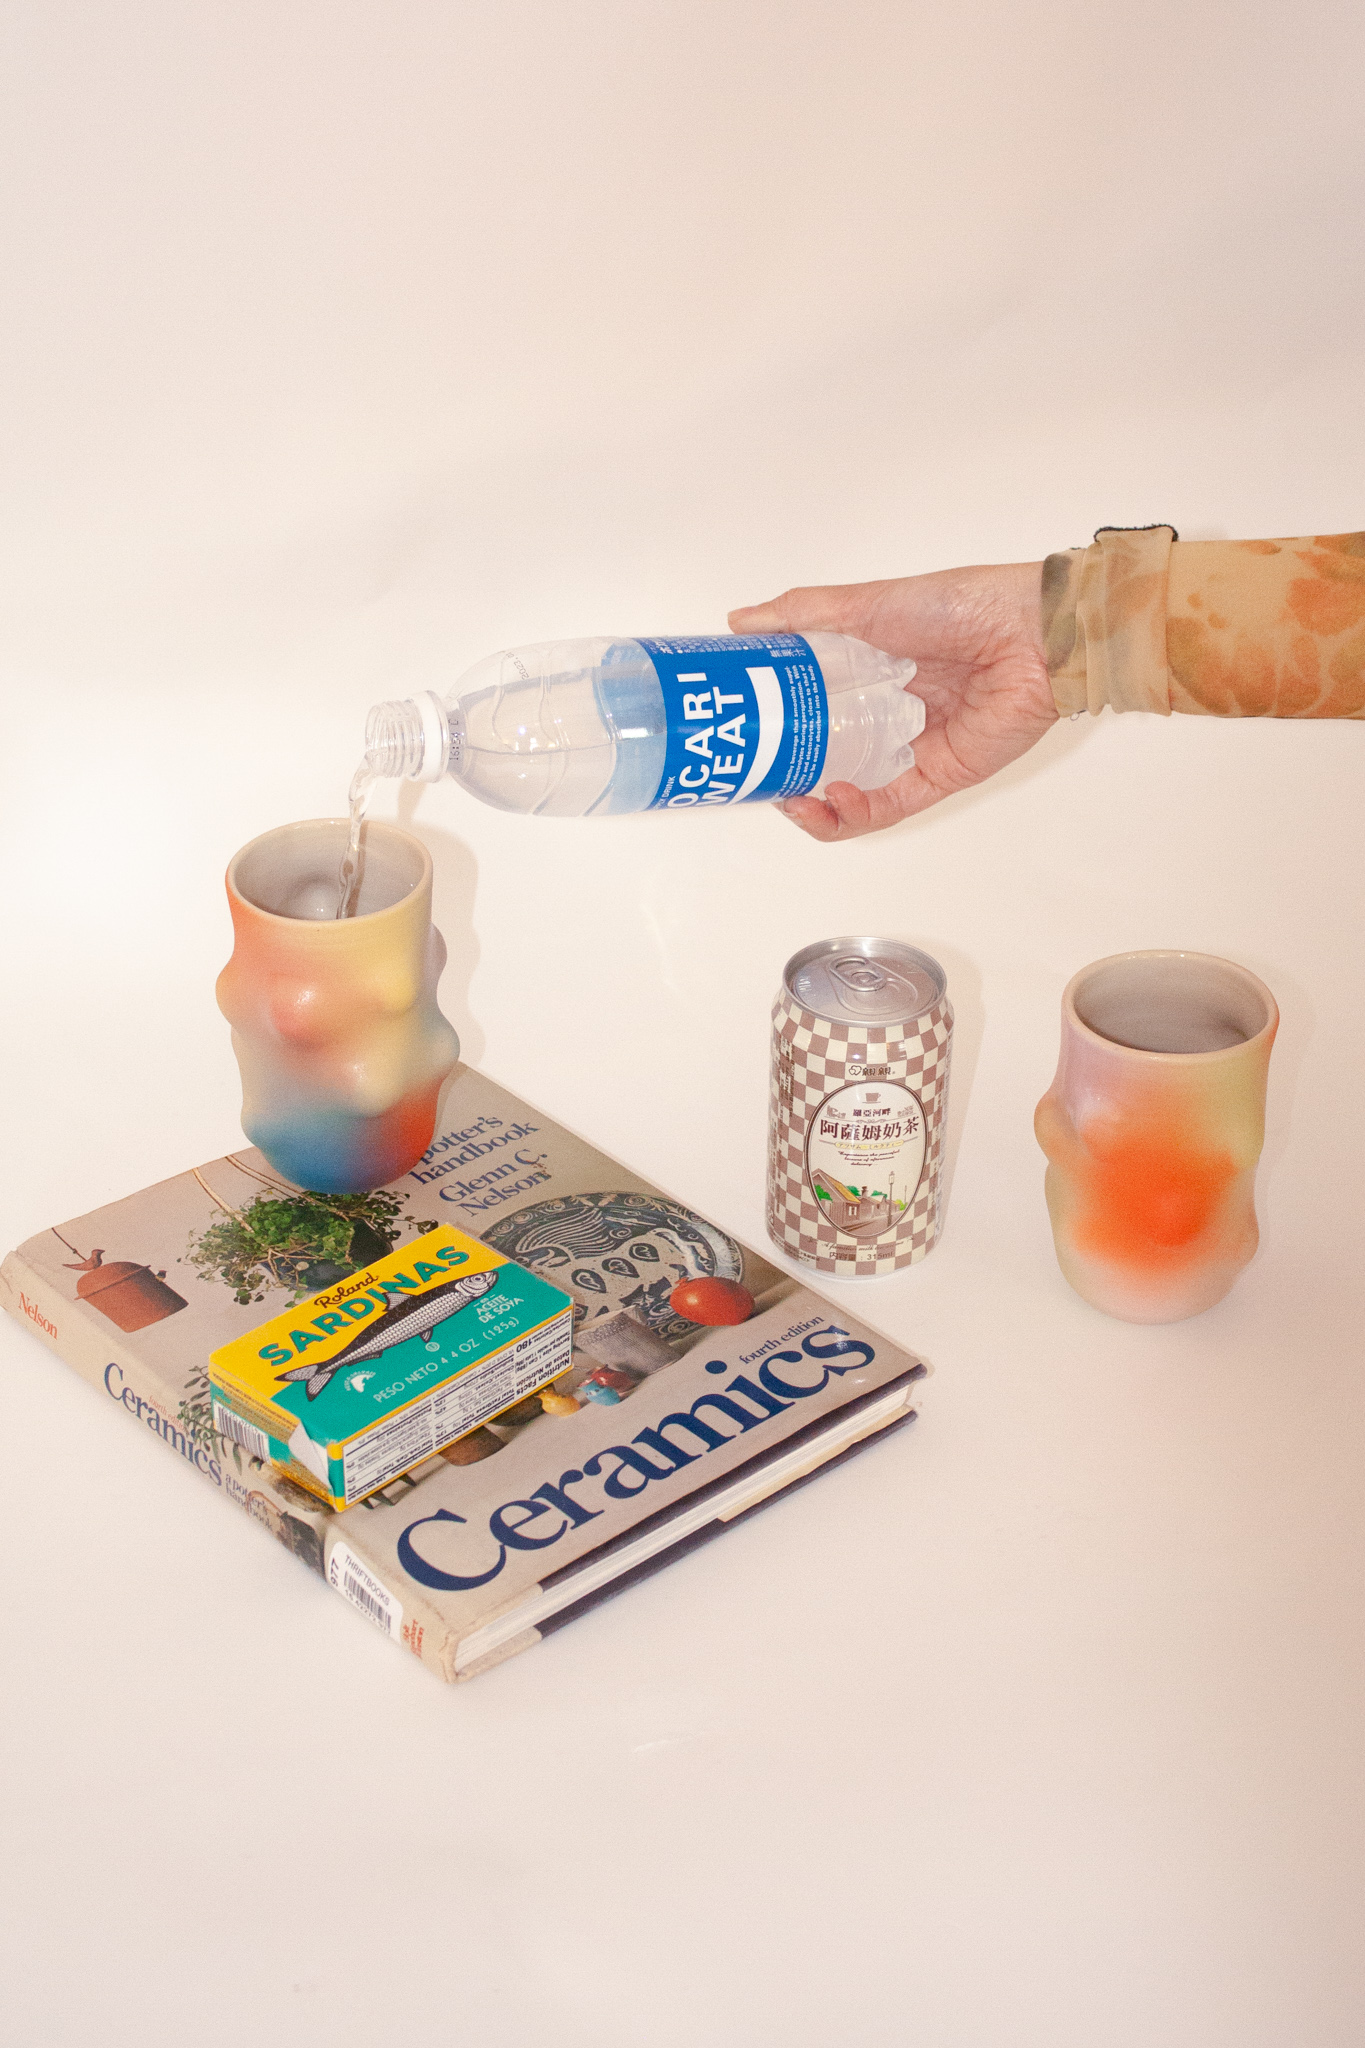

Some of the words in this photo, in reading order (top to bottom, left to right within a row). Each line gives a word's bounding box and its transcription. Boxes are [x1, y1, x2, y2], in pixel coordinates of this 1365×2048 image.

[792, 665, 800, 679] With
[790, 686, 798, 717] smoothly
[790, 735, 799, 764] beverage
[793, 748, 804, 780] electrolytes
[820, 1116, 919, 1141] 阿薩姆奶茶
[408, 1122, 540, 1185] handbook
[439, 1163, 519, 1202] Glenn
[514, 1149, 548, 1165] C.
[456, 1171, 551, 1217] Nelson
[258, 1246, 470, 1366] SARDINAS
[314, 1272, 380, 1309] Roland
[476, 1294, 509, 1316] ACEITE
[18, 1292, 58, 1340] Nelson
[478, 1312, 496, 1324] DE
[493, 1298, 524, 1315] SOYA
[516, 1336, 531, 1353] 180
[552, 1336, 569, 1350] Serving
[739, 1339, 782, 1365] fourth
[780, 1315, 825, 1342] edition
[373, 1382, 405, 1403] PESO
[405, 1362, 438, 1386] NETO
[482, 1316, 520, 1340] (125g)
[538, 1356, 569, 1383] Nutrition
[553, 1349, 569, 1364] Datos
[516, 1366, 543, 1388] Nutrición
[516, 1378, 536, 1397] Facts
[104, 1362, 222, 1486] Ceramics
[397, 1324, 875, 1591] Ceramics
[344, 1555, 390, 1606] THRIFTBOOKS
